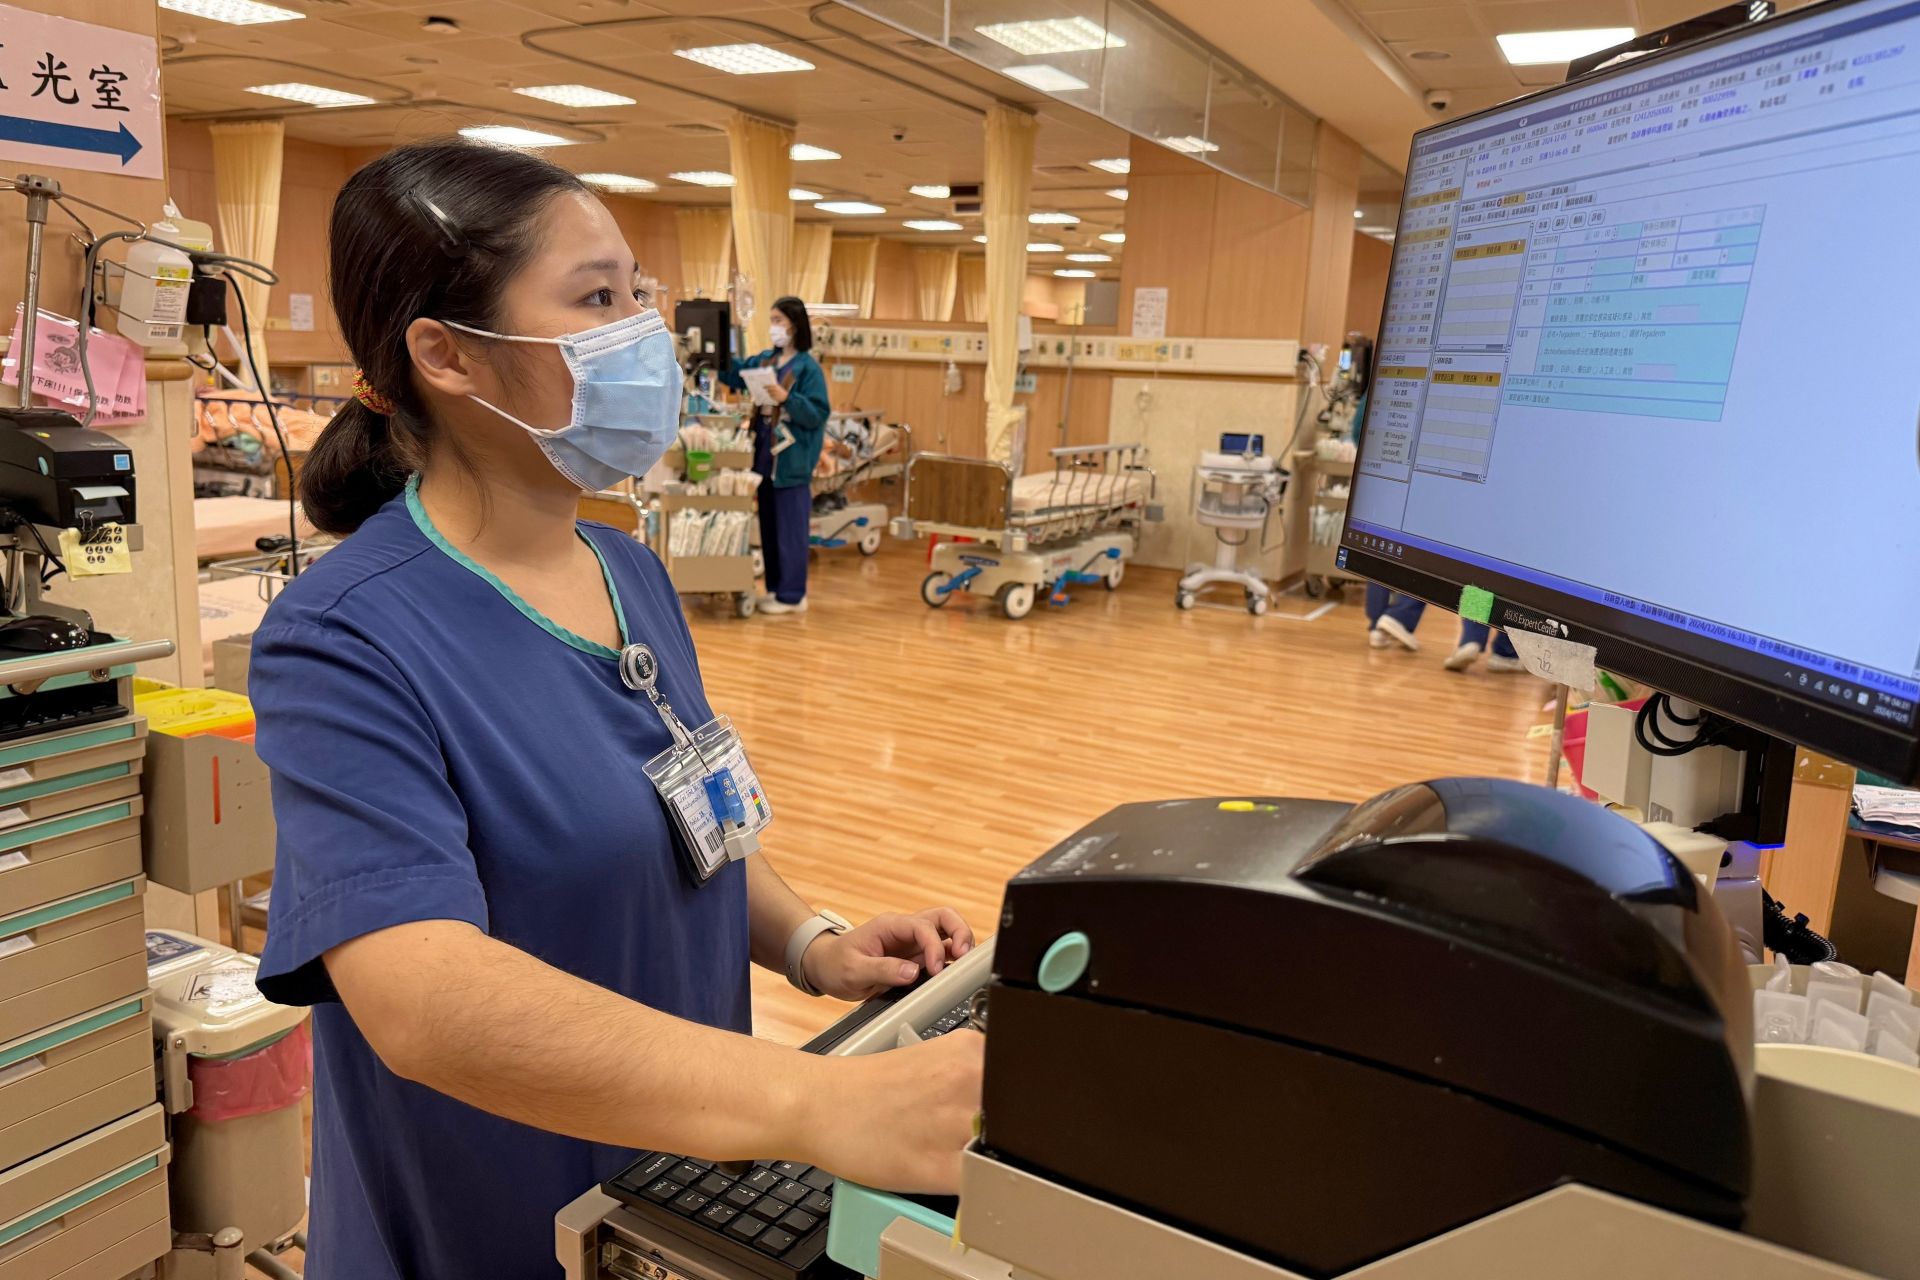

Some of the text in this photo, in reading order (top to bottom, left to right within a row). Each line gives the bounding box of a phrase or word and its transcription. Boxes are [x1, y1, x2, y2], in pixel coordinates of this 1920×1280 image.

[0, 44, 131, 112] 光室
[1503, 609, 1519, 623] ASUS
[1688, 618, 1726, 637] 2024/12/05
